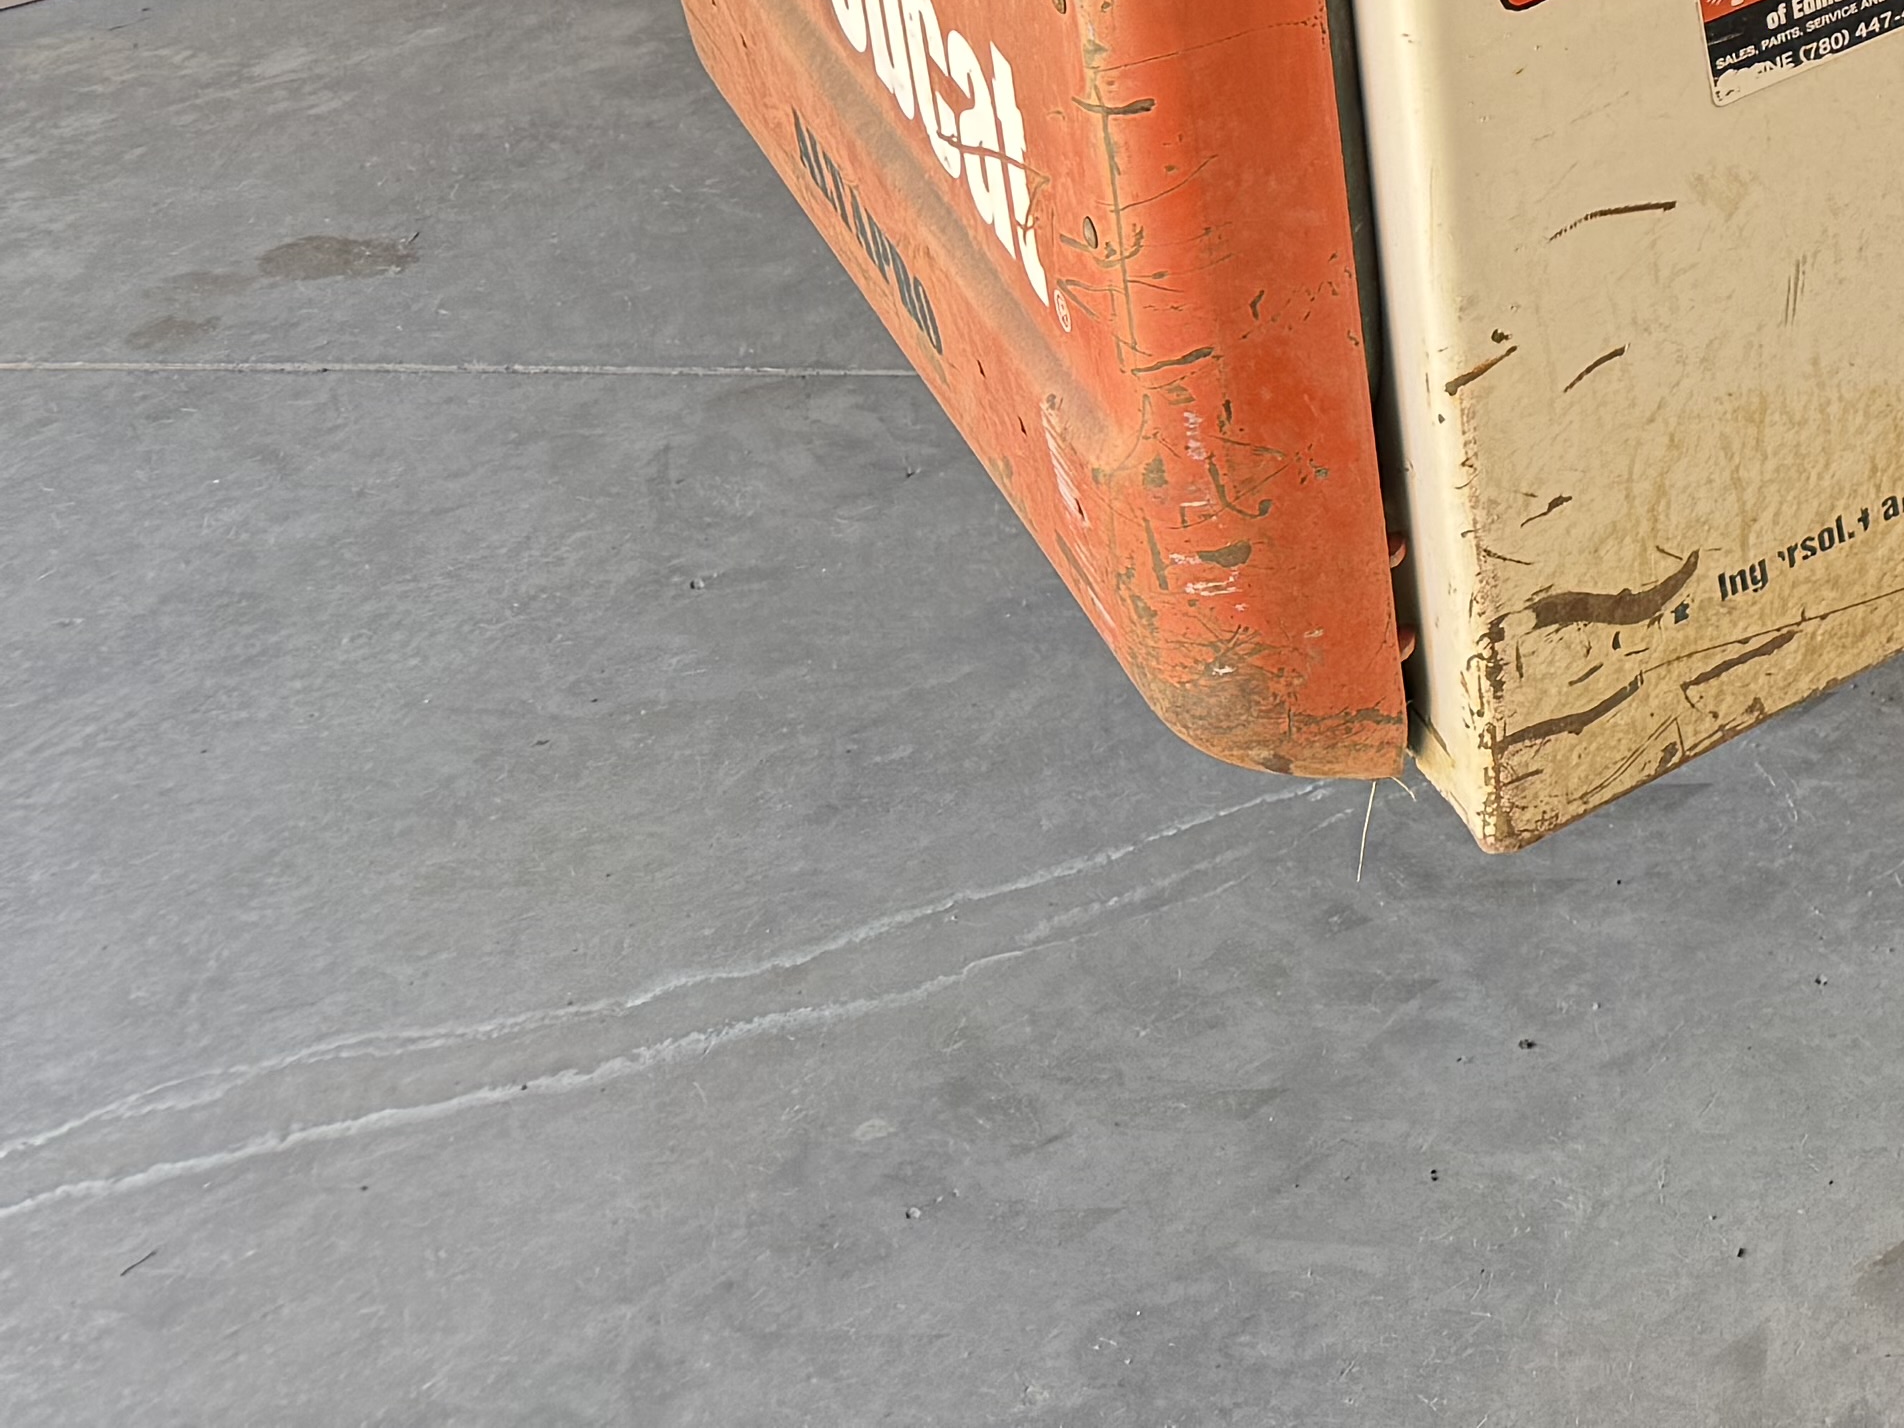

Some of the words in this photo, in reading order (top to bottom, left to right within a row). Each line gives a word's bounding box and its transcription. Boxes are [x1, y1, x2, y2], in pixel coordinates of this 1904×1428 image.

[1716, 45, 1759, 71] SALES,
[1805, 3, 1859, 33] SERVICE
[1766, 7, 1787, 30] of
[1799, 29, 1850, 65] (780)
[792, 108, 944, 356] ALTAPRO
